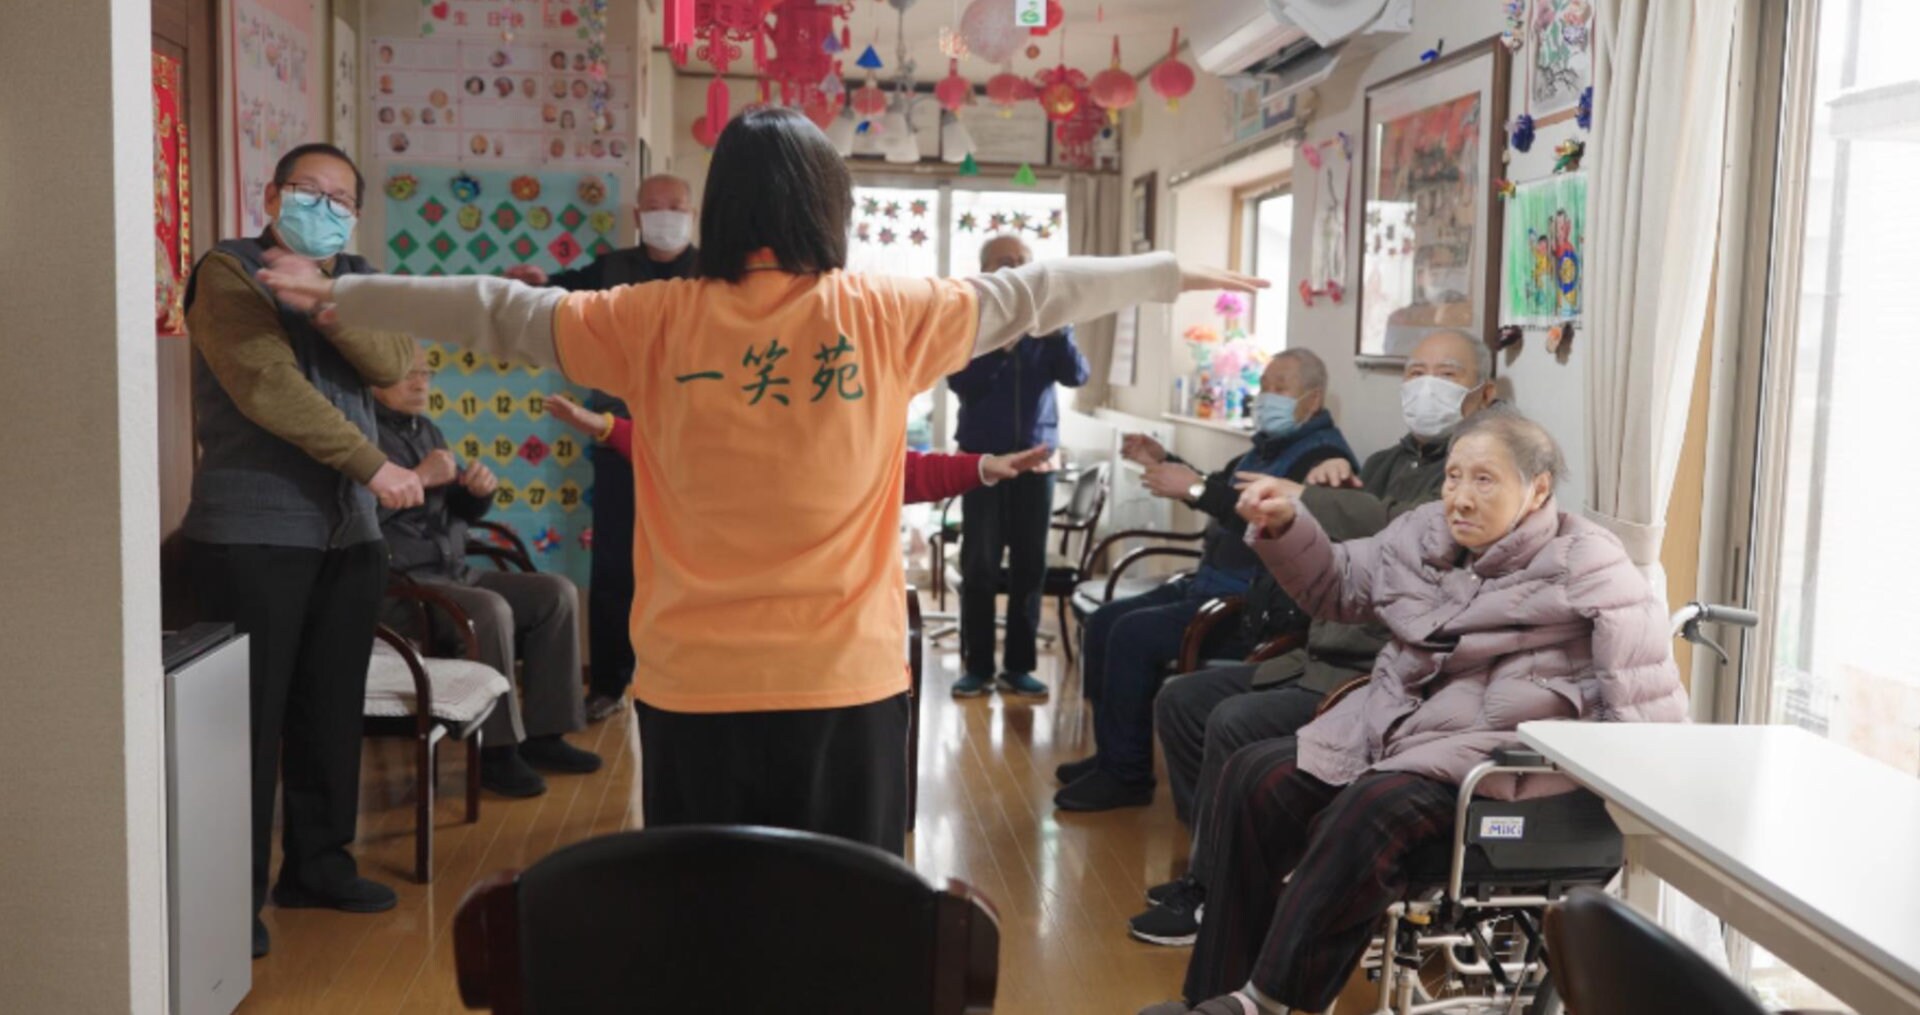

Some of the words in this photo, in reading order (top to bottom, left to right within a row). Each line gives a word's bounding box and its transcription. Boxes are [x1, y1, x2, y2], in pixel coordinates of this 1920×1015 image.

[559, 240, 570, 258] 3
[428, 350, 441, 368] 3
[462, 351, 475, 367] 4
[674, 334, 864, 406] 一笑苑
[429, 393, 445, 411] 10
[462, 397, 476, 415] 11
[496, 396, 511, 414] 12
[529, 396, 543, 414] 13
[463, 439, 479, 457] 18
[495, 439, 513, 457] 19
[527, 441, 542, 460] 20
[556, 440, 572, 457] 21
[497, 486, 514, 503] 26
[528, 487, 546, 505] 27
[561, 487, 578, 505] 28
